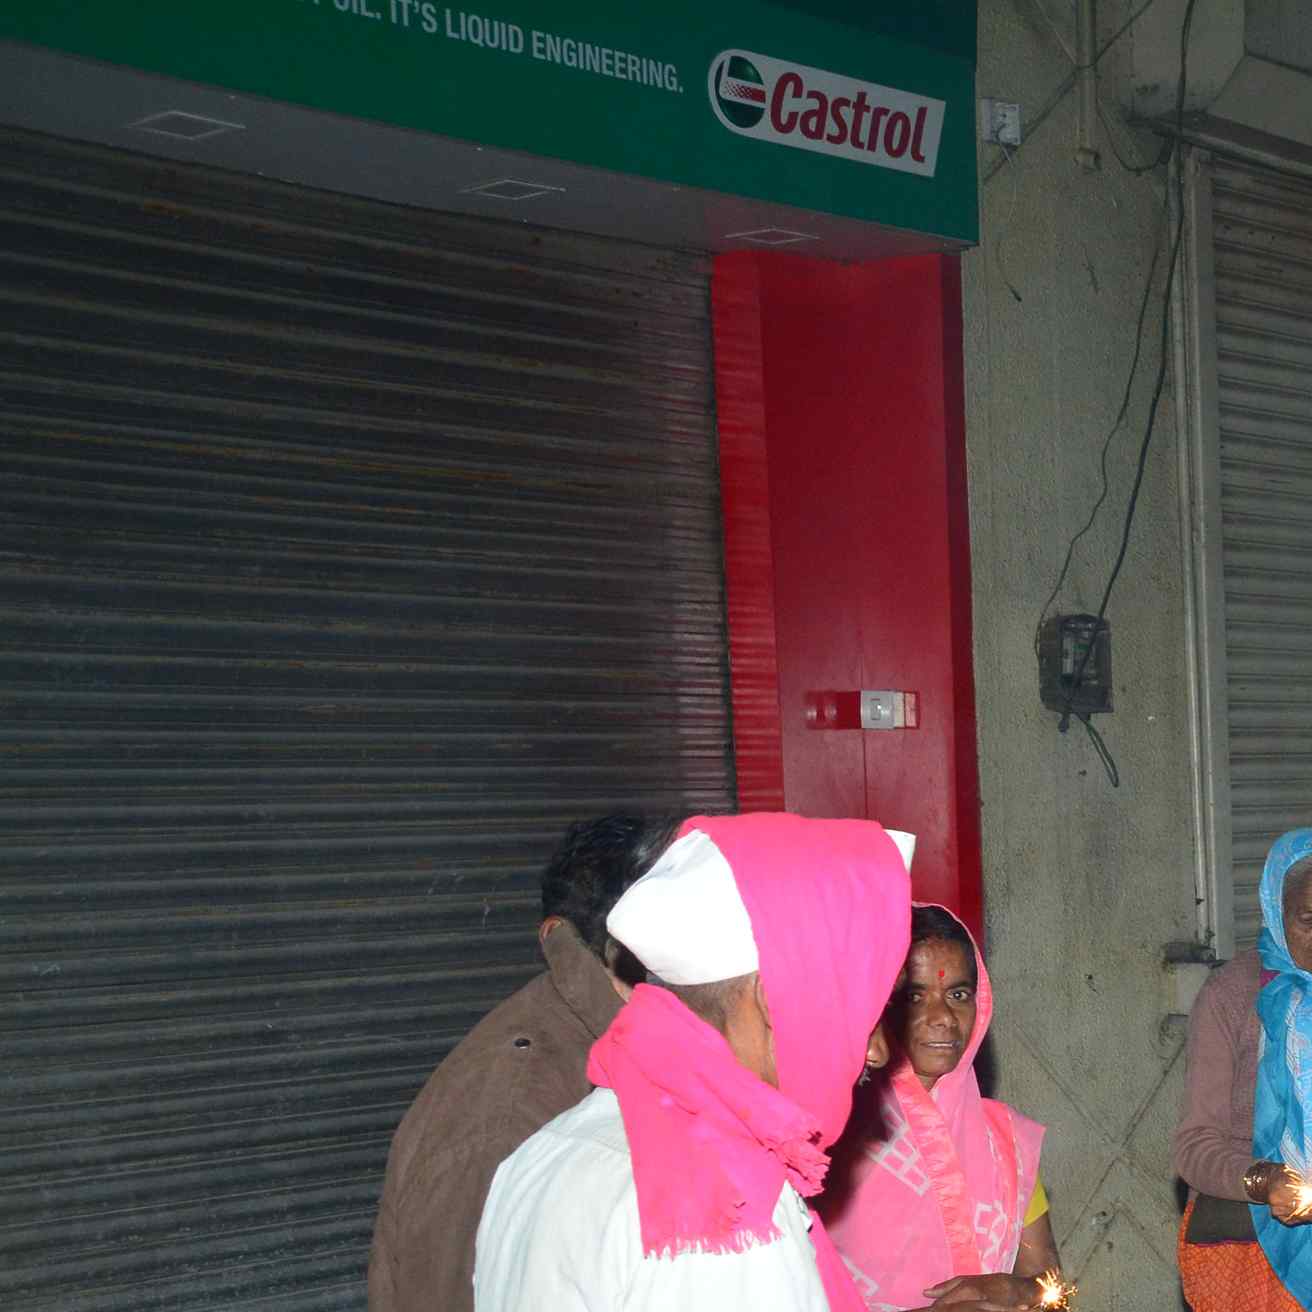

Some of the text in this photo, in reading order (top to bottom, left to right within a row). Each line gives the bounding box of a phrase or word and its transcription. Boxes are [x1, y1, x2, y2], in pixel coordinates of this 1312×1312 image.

[390, 0, 437, 33] IT'S
[445, 8, 525, 54] LIQUID
[531, 29, 685, 94] ENGINEERING.
[770, 72, 929, 163] Castrol
